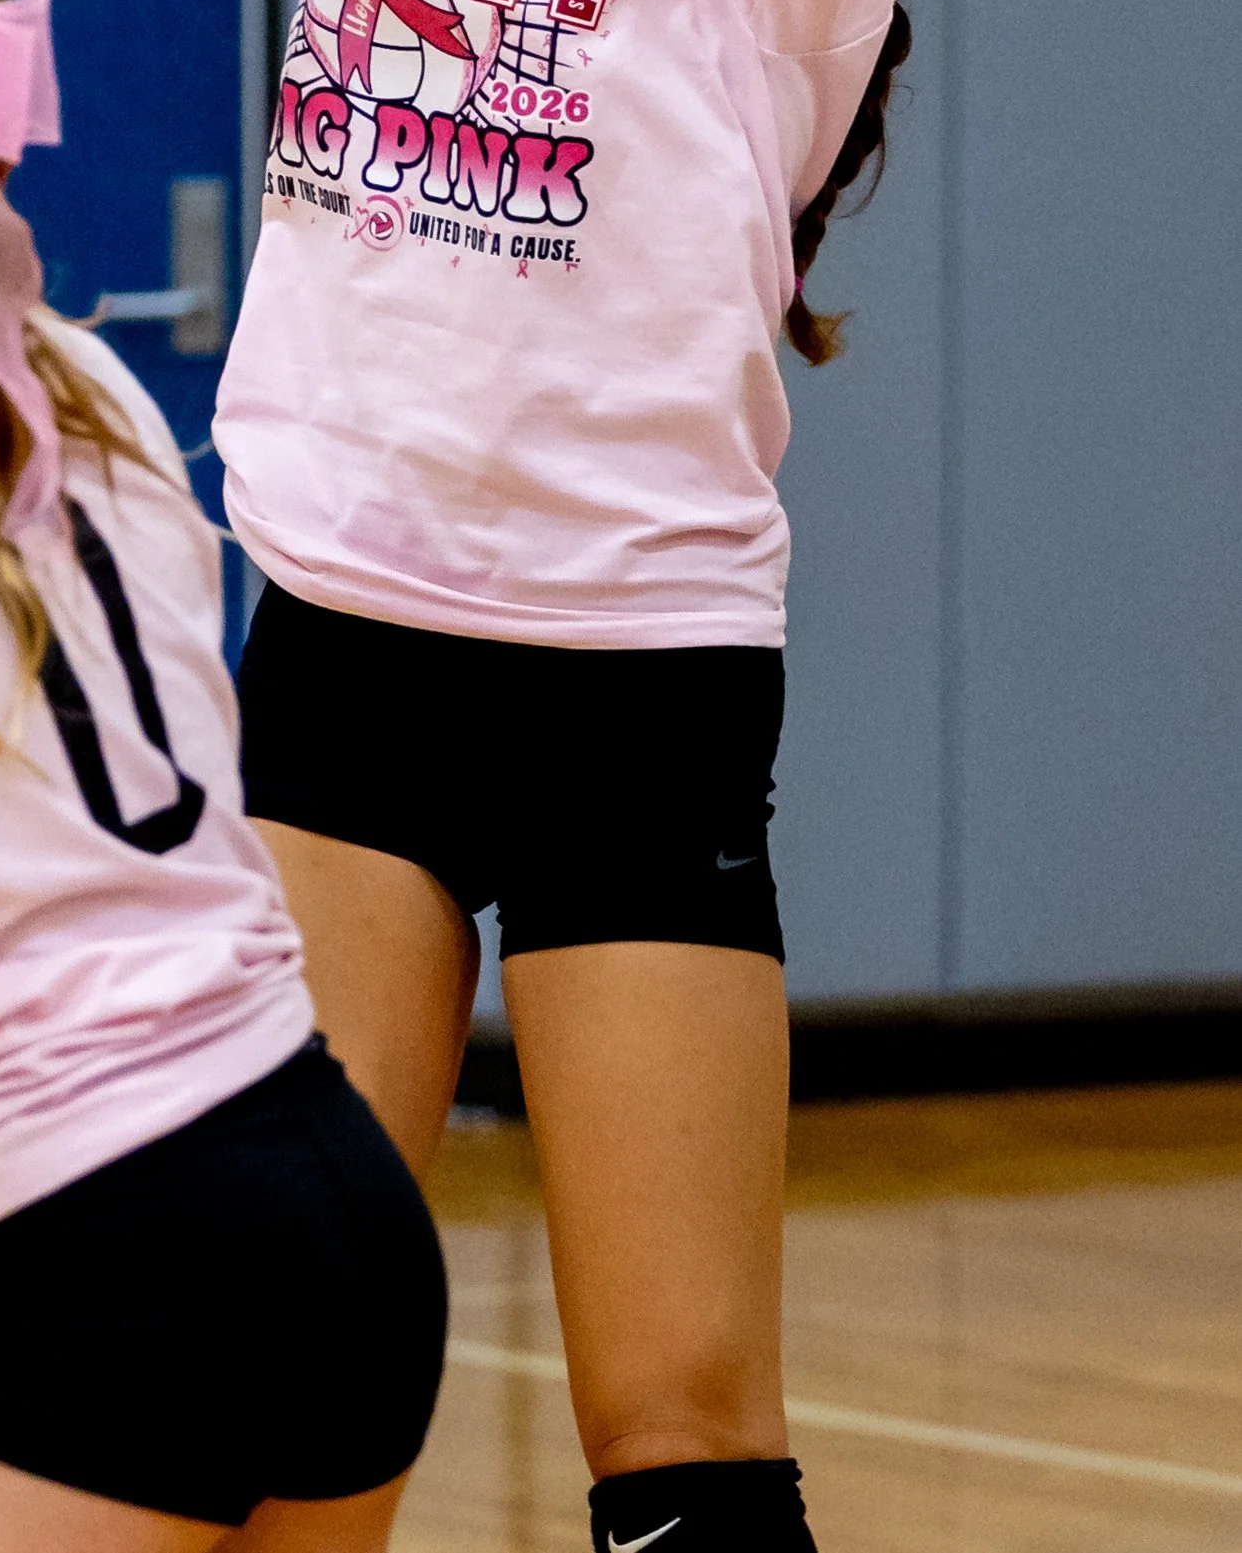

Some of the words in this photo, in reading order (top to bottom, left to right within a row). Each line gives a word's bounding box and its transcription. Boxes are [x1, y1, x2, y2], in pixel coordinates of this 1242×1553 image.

[490, 81, 590, 123] 2026
[267, 77, 353, 181] IG
[361, 100, 594, 227] PINK
[277, 174, 296, 198] ON
[297, 178, 318, 206] THE
[409, 211, 460, 245] UNITED
[464, 224, 486, 253] FOR
[490, 232, 502, 256] A
[510, 235, 581, 263] CAUSE.
